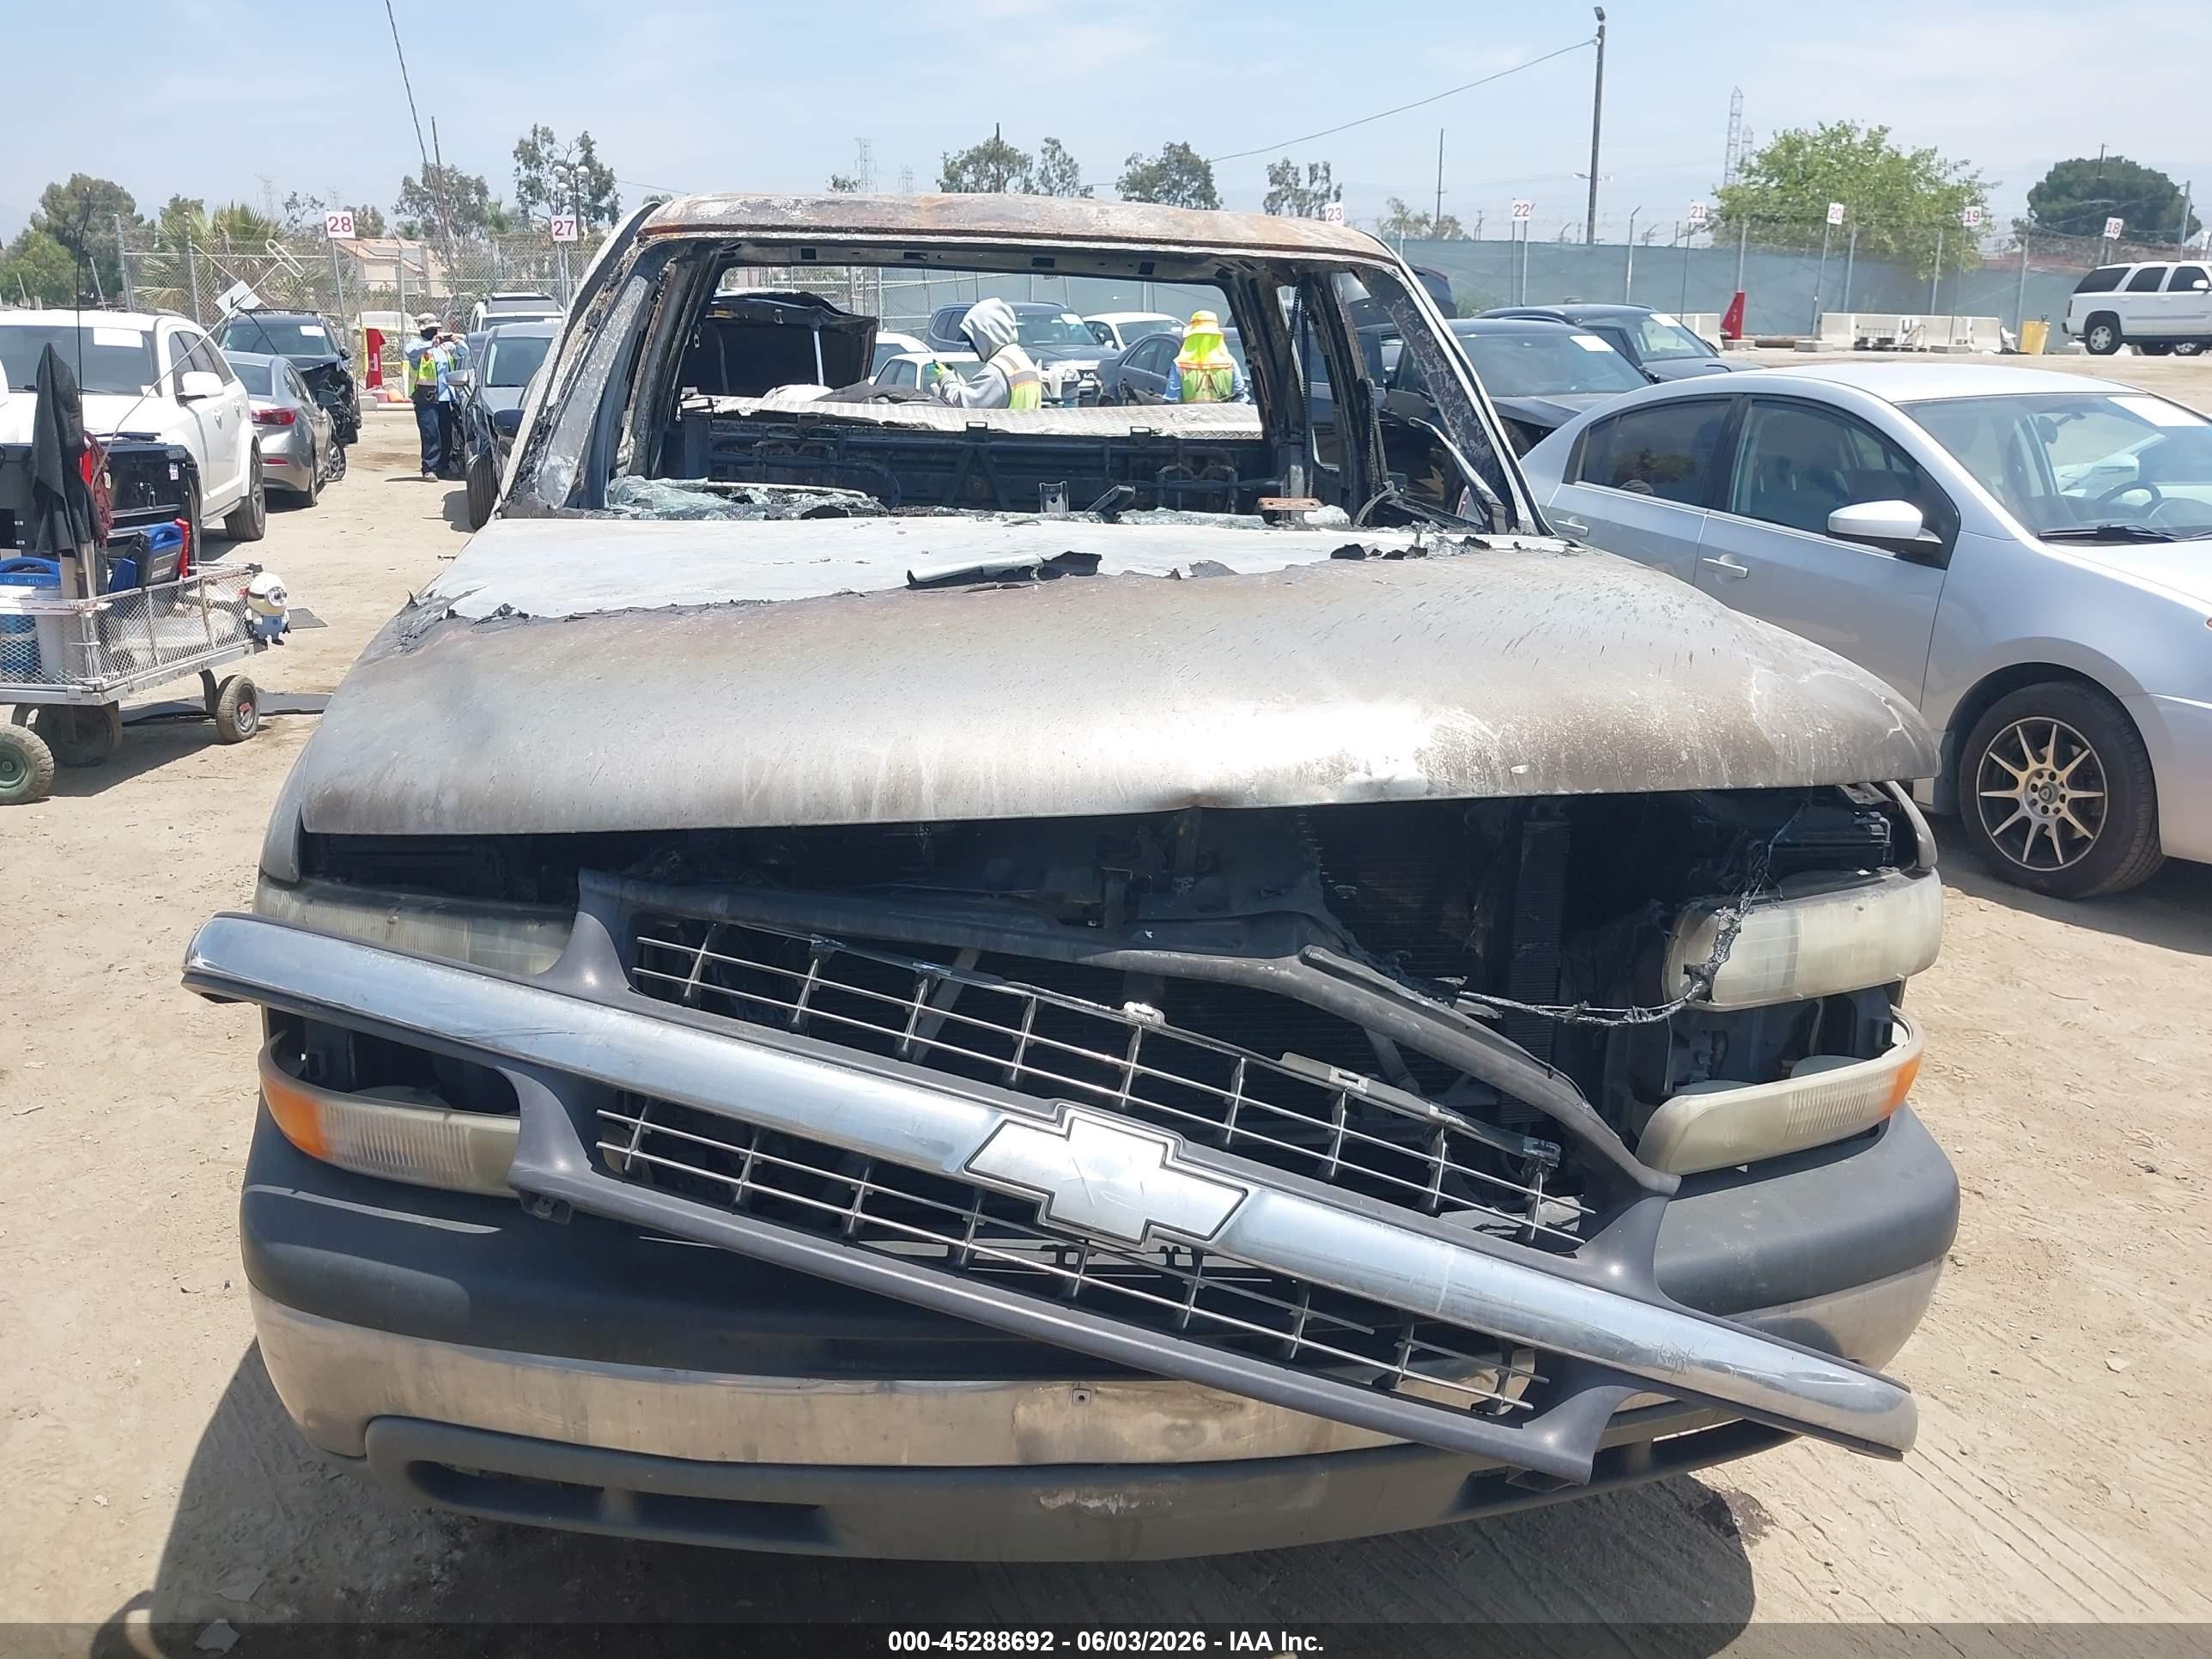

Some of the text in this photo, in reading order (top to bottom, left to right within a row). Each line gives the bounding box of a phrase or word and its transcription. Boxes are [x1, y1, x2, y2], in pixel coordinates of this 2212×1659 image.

[1328, 208, 1342, 222] 23
[1513, 204, 1529, 217] 22
[1692, 206, 1704, 219] 21
[1830, 207, 1843, 221] 20
[1965, 211, 1979, 223] 19
[328, 216, 352, 233] 28
[554, 220, 575, 236] 27
[2108, 222, 2121, 234] 18
